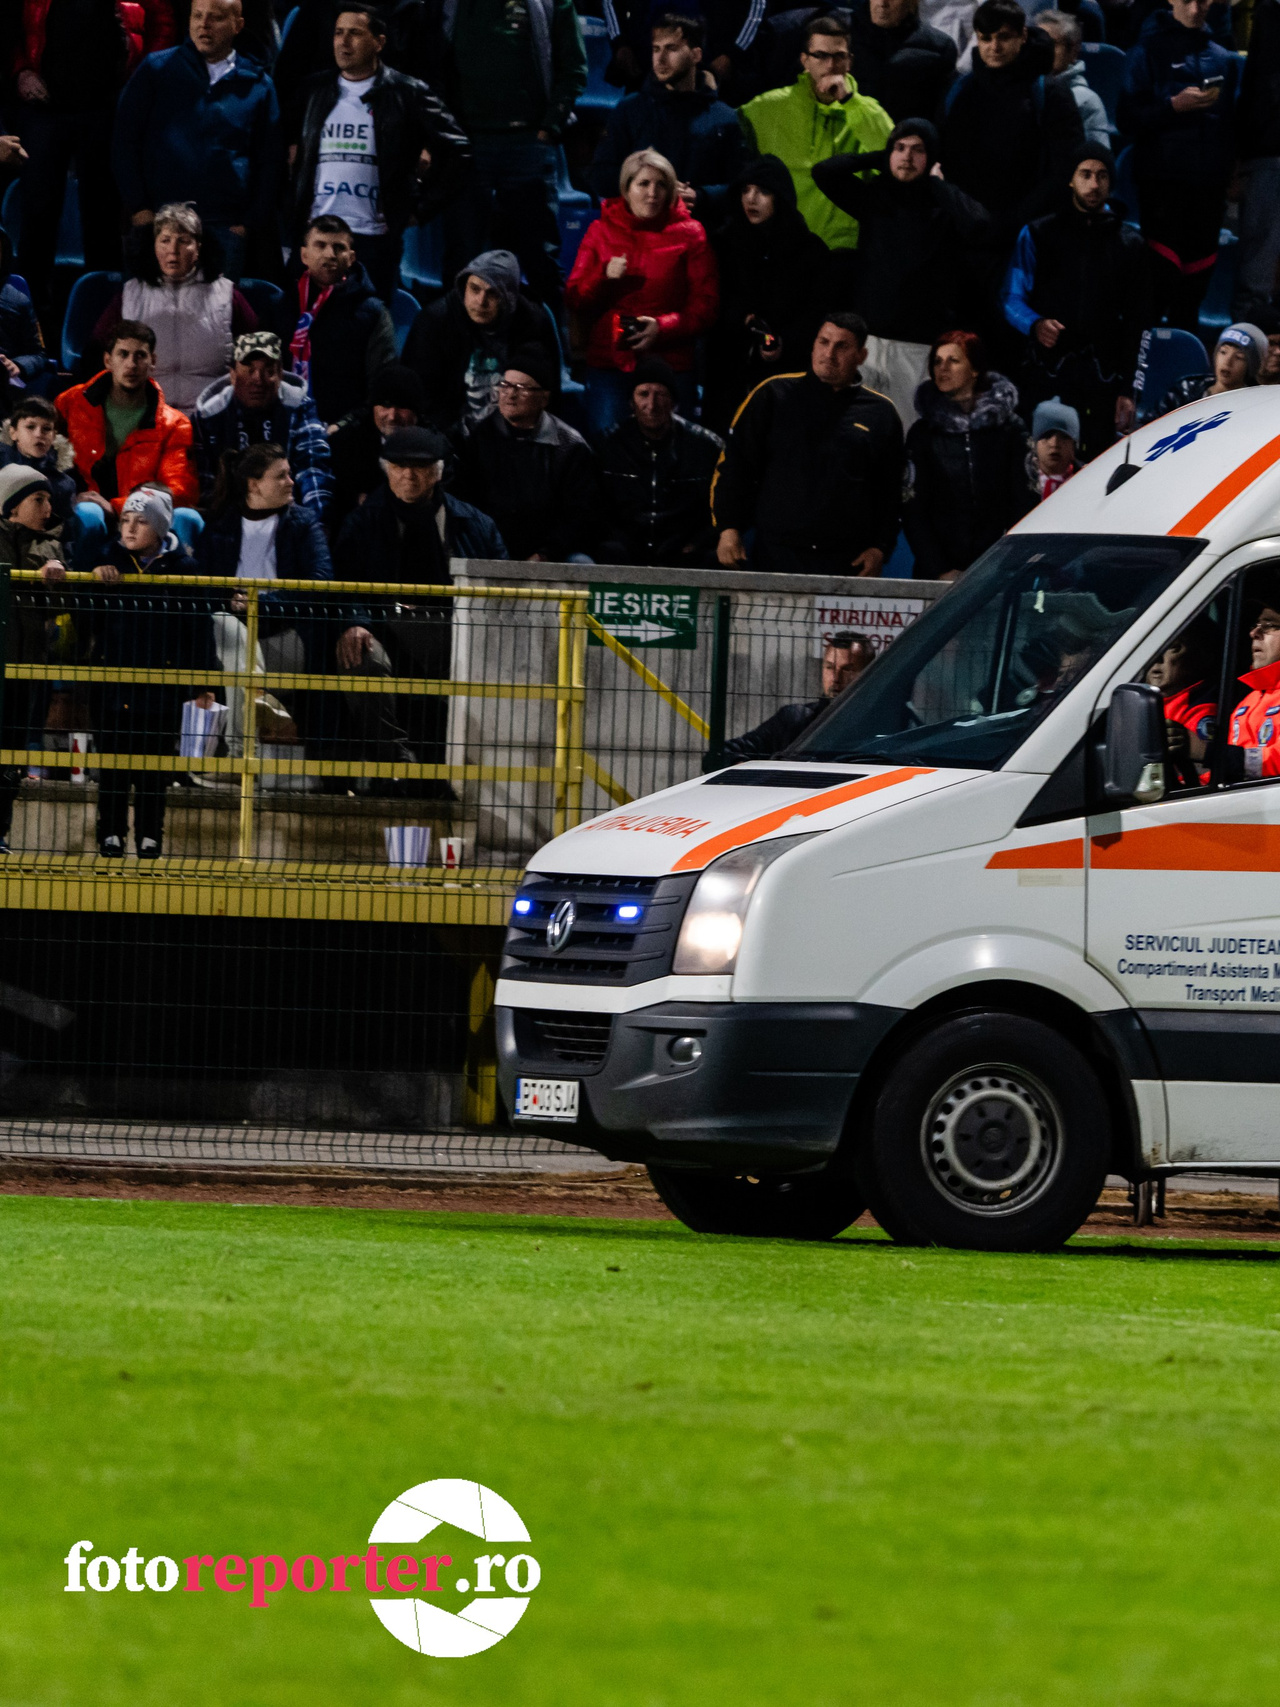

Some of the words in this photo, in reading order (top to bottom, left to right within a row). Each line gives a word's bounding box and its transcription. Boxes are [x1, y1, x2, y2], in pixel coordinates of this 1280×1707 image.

[320, 122, 370, 140] NIBE
[594, 591, 691, 619] IESIRE
[819, 607, 905, 628] TRIBUNA
[1125, 934, 1203, 953] SERVICIUL
[1117, 958, 1207, 978] Compartiment
[1210, 961, 1270, 979] Asistenta
[1185, 983, 1246, 1005] Transport
